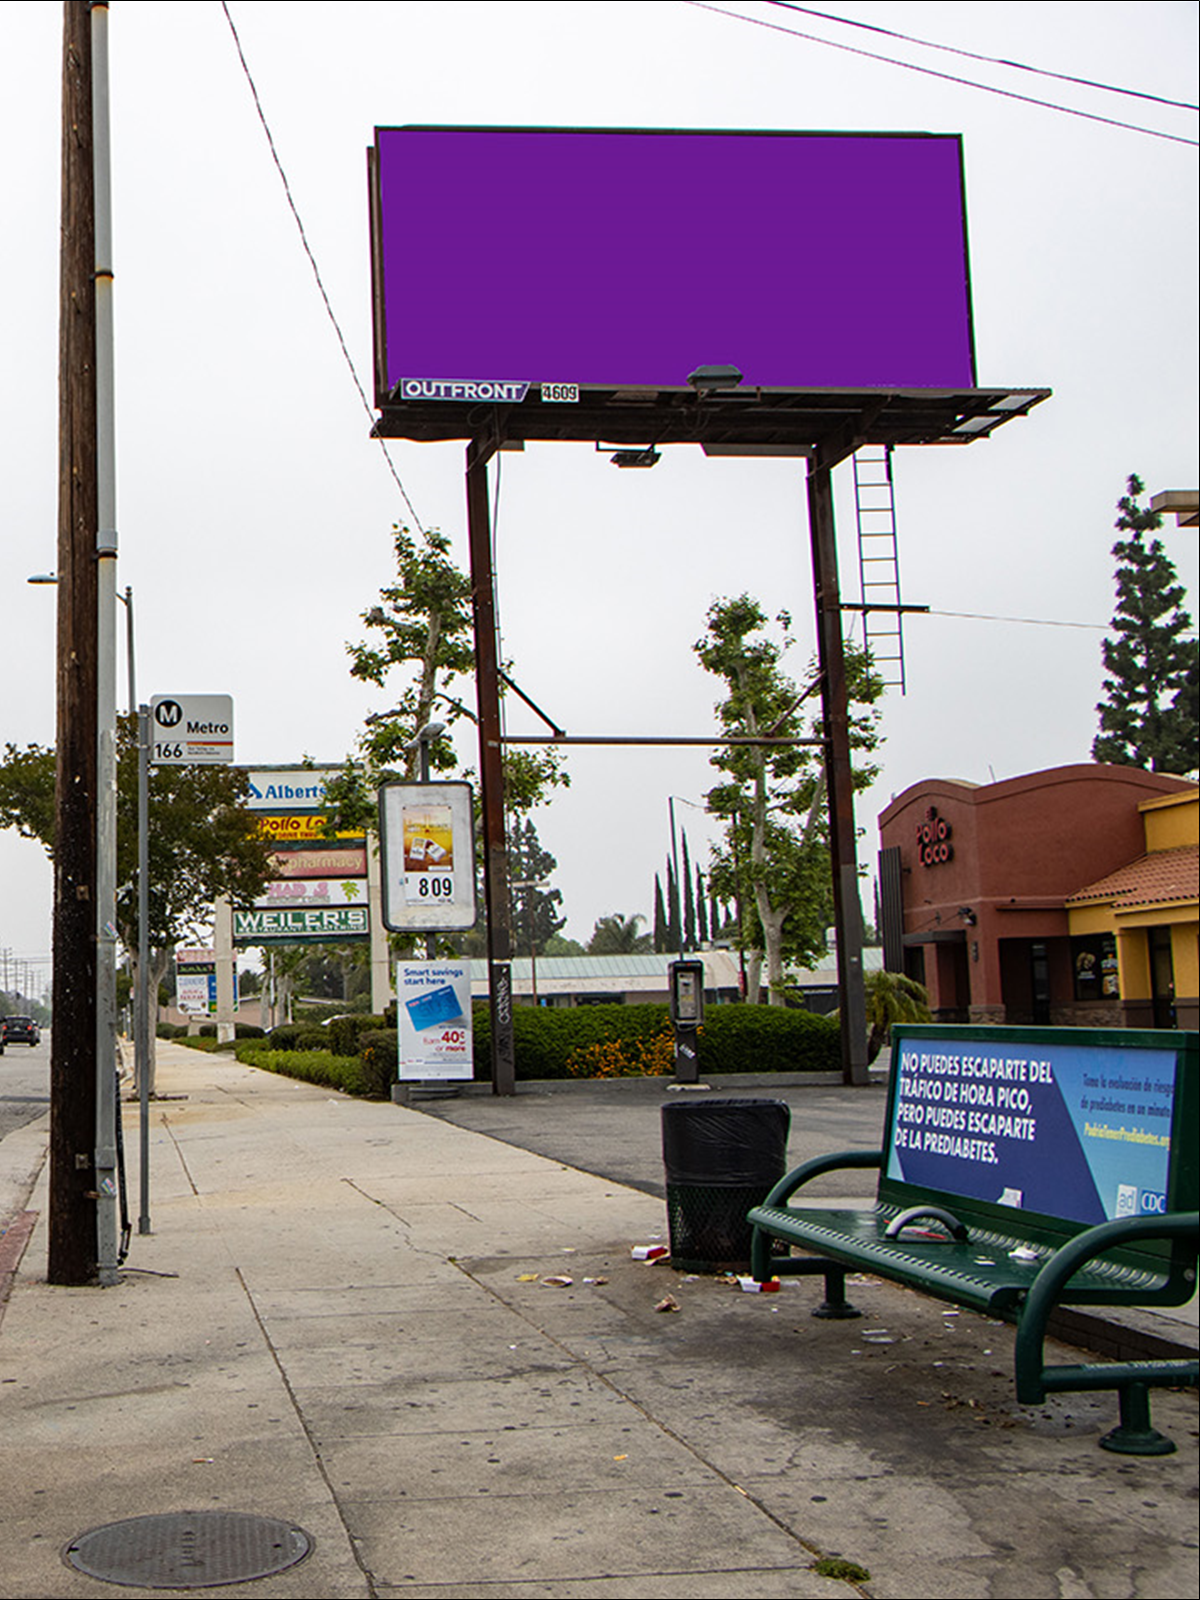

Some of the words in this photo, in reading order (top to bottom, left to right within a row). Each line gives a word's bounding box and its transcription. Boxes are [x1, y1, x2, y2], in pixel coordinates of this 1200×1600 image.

[405, 381, 522, 399] OUTFRONT
[542, 385, 577, 401] 4609
[187, 721, 229, 734] Metro
[155, 743, 183, 759] 166
[915, 817, 948, 845] Pollo
[918, 844, 949, 866] Loco
[418, 877, 452, 897] 809
[238, 910, 364, 929] WEILER'S
[403, 968, 430, 977] Smart
[431, 967, 464, 979] savings
[403, 978, 425, 986] start
[425, 977, 446, 986] here
[901, 1052, 919, 1073] NO
[920, 1054, 960, 1076] PUEDES
[961, 1056, 1027, 1082] ESCAPARTE
[1029, 1060, 1053, 1084] DEL
[900, 1073, 942, 1101] TRÁFICO
[944, 1081, 959, 1103] DE
[959, 1083, 995, 1107] HORA
[997, 1087, 1033, 1115] PICO,
[897, 1102, 925, 1125] PERO
[925, 1106, 967, 1131] PUEDES
[967, 1111, 1036, 1141] ESCAPARTE
[895, 1127, 908, 1148] DE
[908, 1129, 922, 1150] LA
[923, 1131, 999, 1165] PREDIABETES.
[1142, 1191, 1166, 1214] CDC
